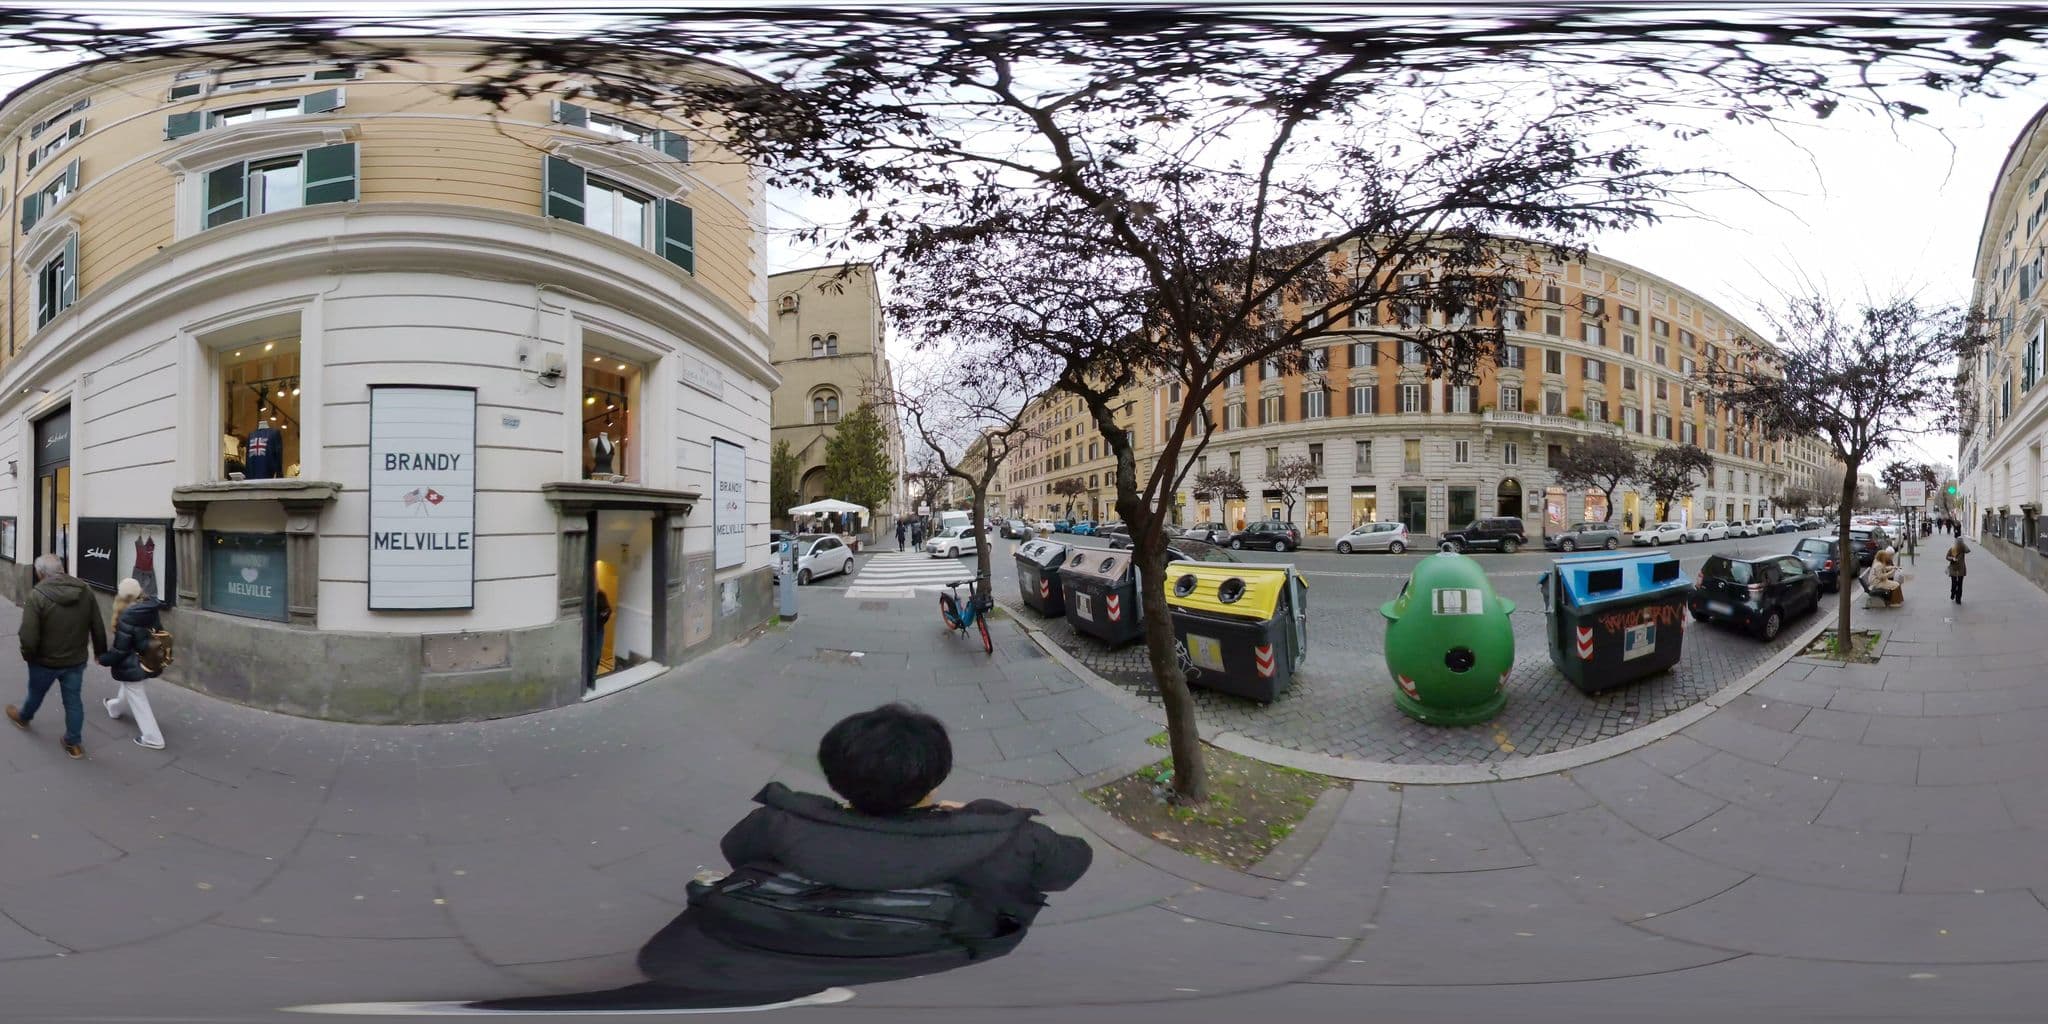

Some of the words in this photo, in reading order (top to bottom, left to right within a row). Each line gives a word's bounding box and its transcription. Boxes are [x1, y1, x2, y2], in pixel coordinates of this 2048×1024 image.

[385, 453, 460, 471] BRANDY
[719, 481, 742, 493] BRANDY
[716, 523, 745, 536] MELVILLE
[374, 532, 470, 550] MELVILLE
[228, 581, 272, 598] MELVILLE
